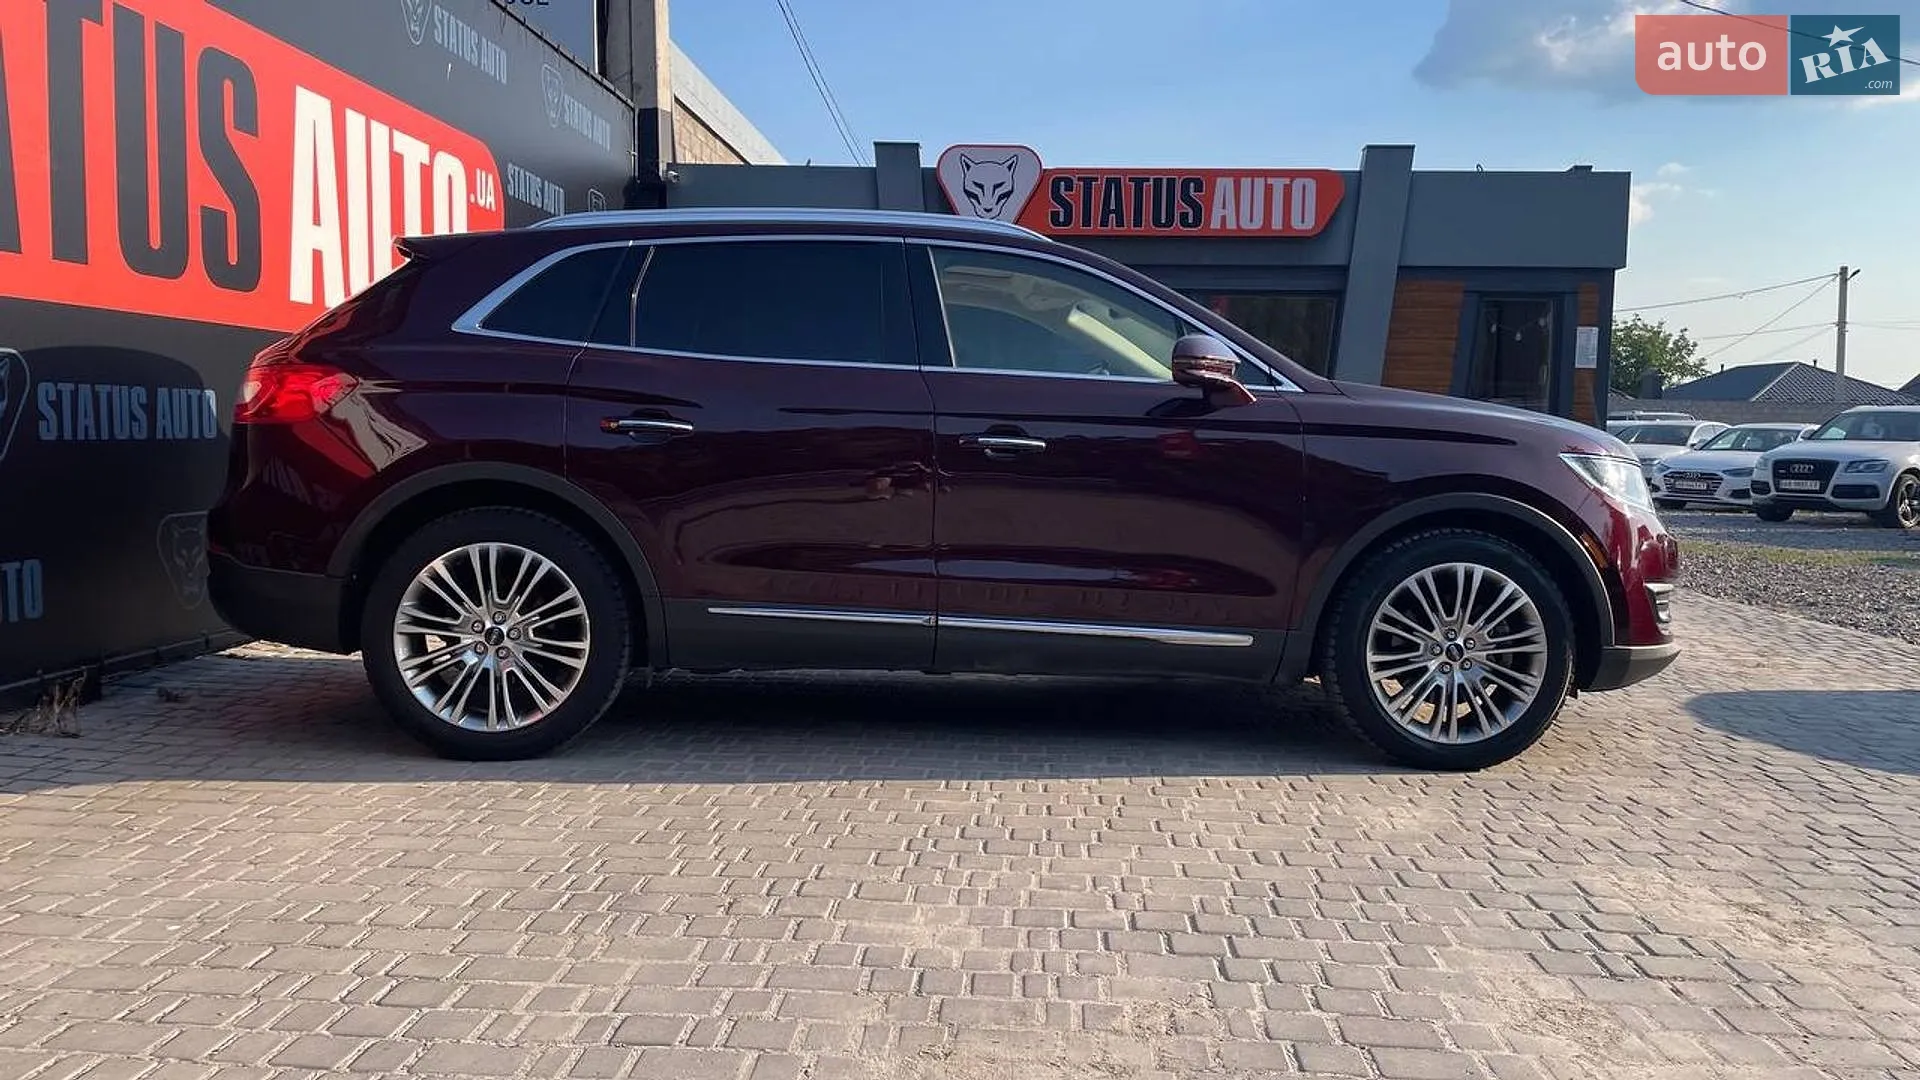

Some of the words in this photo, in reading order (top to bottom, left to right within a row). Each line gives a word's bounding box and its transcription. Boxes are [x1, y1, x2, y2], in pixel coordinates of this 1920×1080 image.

[434, 5, 479, 67] STATUS
[481, 36, 507, 85] AUTO
[0, 0, 260, 293] TUS
[508, 162, 542, 207] STATUS
[1049, 174, 1205, 230] STATUS
[1210, 176, 1318, 231] AUTO
[37, 382, 148, 441] STATUS
[156, 387, 218, 440] AUTO
[0, 559, 44, 623] TO
